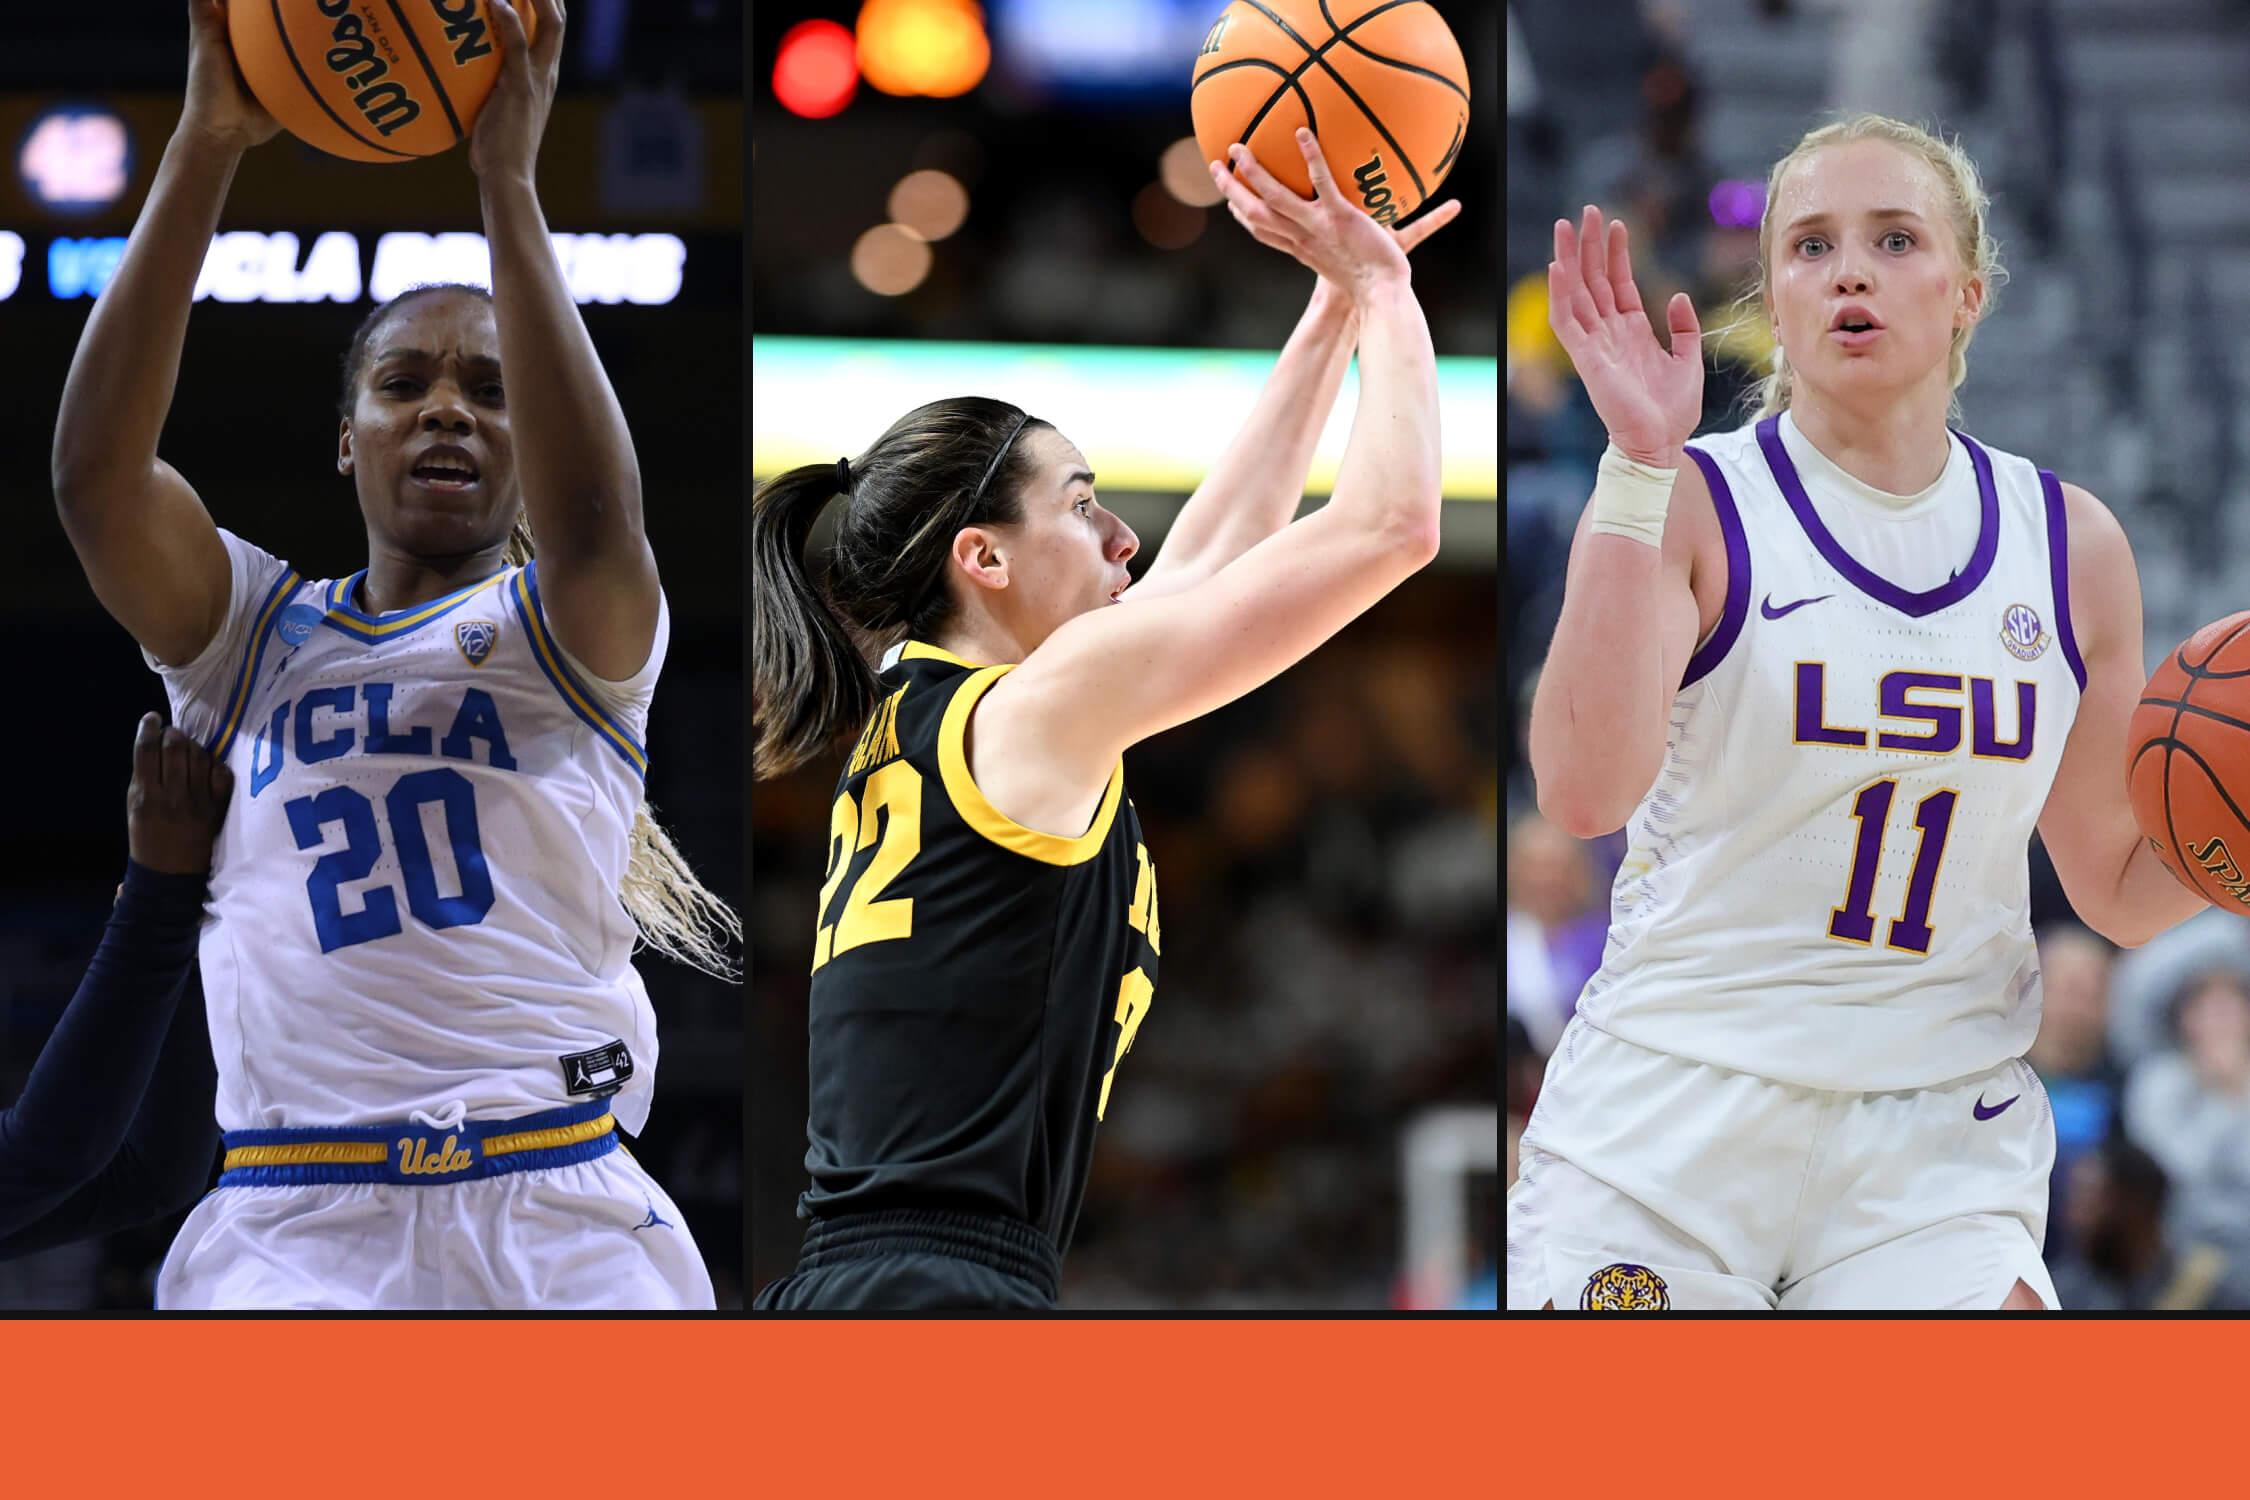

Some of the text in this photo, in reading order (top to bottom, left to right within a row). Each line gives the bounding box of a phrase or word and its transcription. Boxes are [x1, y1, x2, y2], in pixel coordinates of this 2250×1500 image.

[457, 623, 494, 648] PAC
[466, 638, 486, 656] 12
[2007, 606, 2039, 646] SEC
[249, 682, 518, 799] UCLA
[1793, 661, 2038, 762] LSU
[283, 767, 497, 955] 20
[810, 759, 923, 976] 22
[1826, 776, 1961, 957] 11
[615, 1051, 630, 1069] 42
[397, 1134, 473, 1175] Ucla
